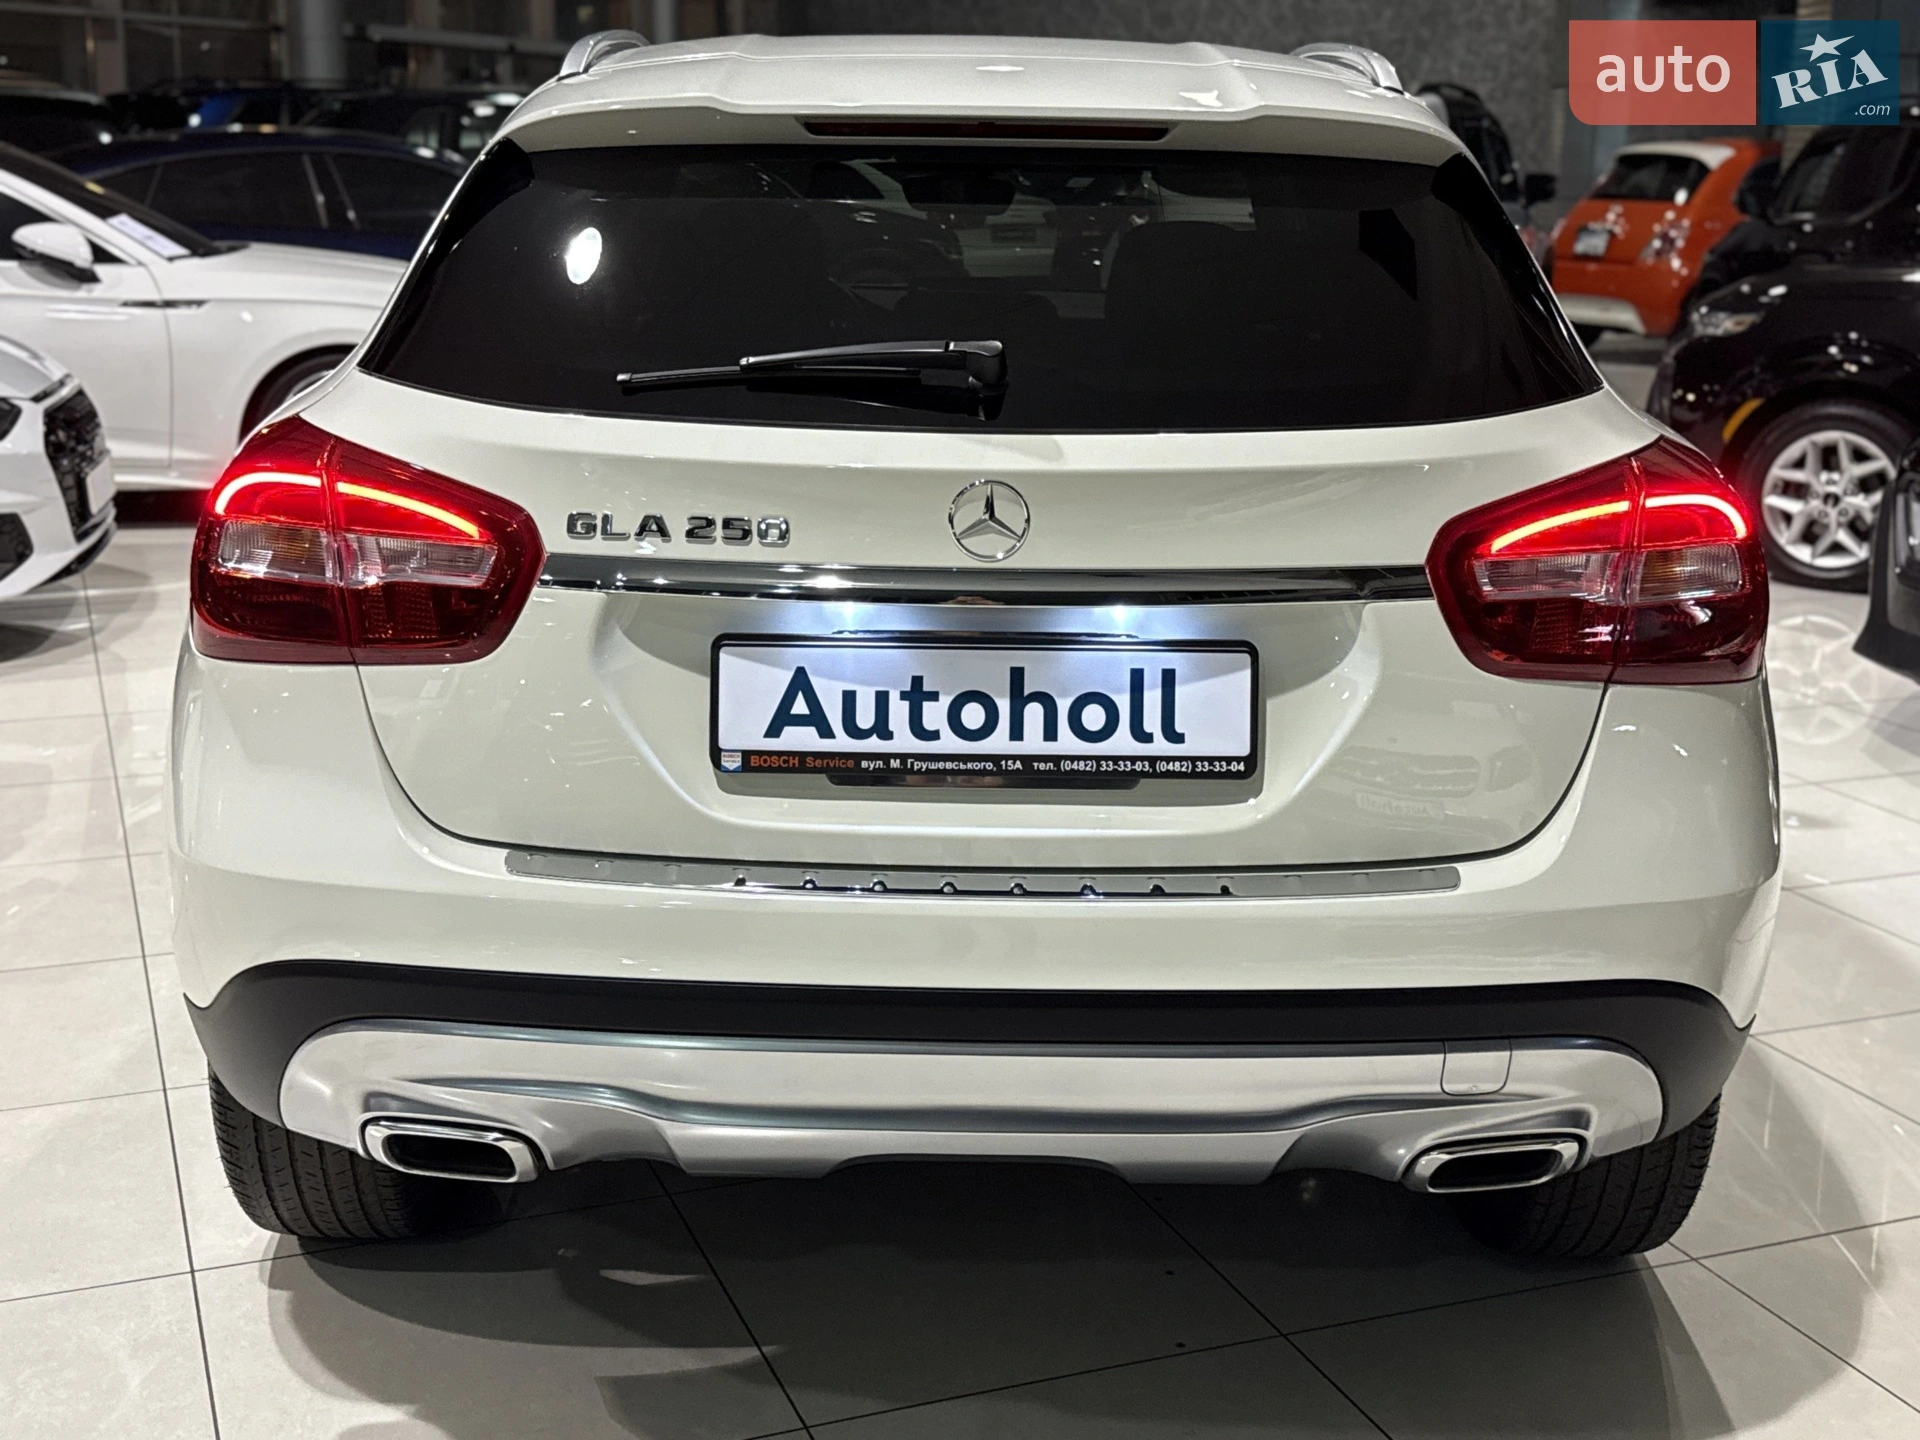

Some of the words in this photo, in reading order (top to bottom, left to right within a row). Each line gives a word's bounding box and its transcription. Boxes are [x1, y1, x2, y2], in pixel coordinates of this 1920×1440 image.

[566, 511, 672, 543] GLA
[685, 515, 791, 547] 250
[763, 665, 1186, 744] Autoholl
[750, 755, 799, 767] BOSCH
[805, 757, 855, 768] Service
[861, 760, 887, 772] вул.
[907, 759, 997, 772] Грушевського,
[1032, 762, 1057, 771] тел.
[1060, 760, 1097, 773] (0482)
[1100, 761, 1153, 774] 33-33-03,
[1156, 760, 1192, 774] (0482)
[1195, 761, 1245, 773] 33-33-04
